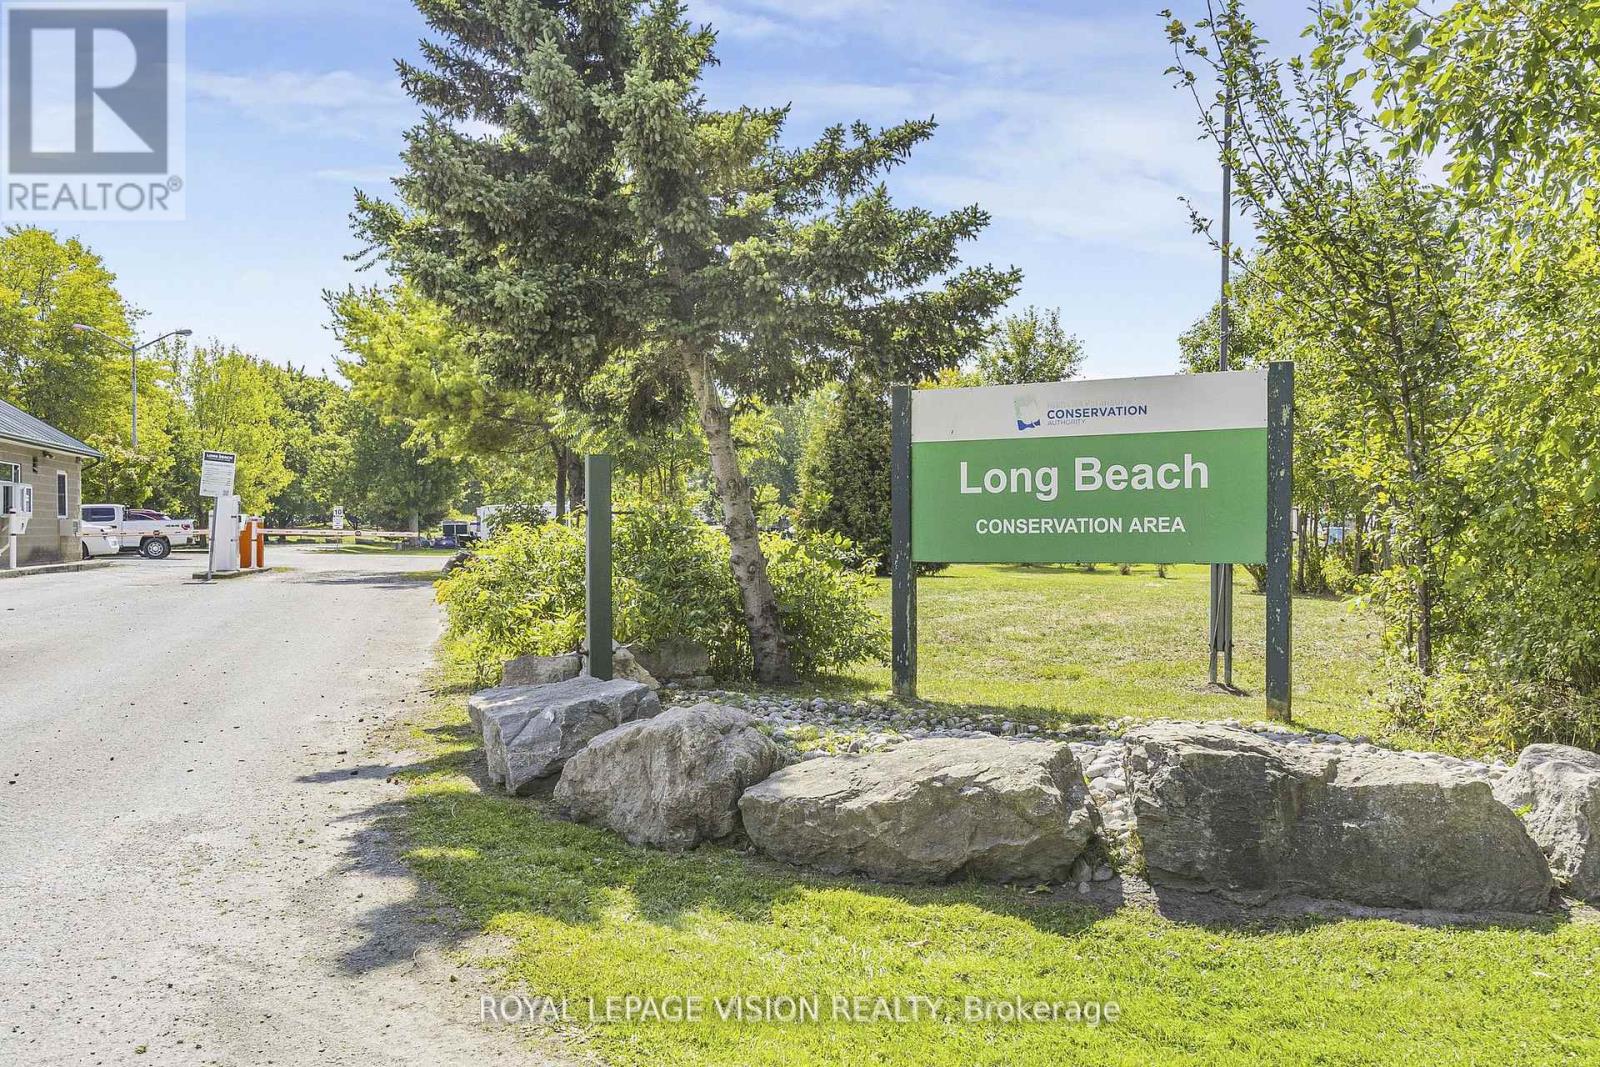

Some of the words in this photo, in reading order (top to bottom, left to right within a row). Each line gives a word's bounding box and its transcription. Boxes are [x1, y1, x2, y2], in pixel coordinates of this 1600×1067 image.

[1047, 405, 1147, 419] CONSERVATION
[1047, 418, 1086, 426] AUTHORITY
[960, 461, 1059, 501] Long
[1074, 453, 1209, 492] Beach
[975, 517, 1123, 535] CONSERVATION
[1128, 516, 1186, 533] AREA
